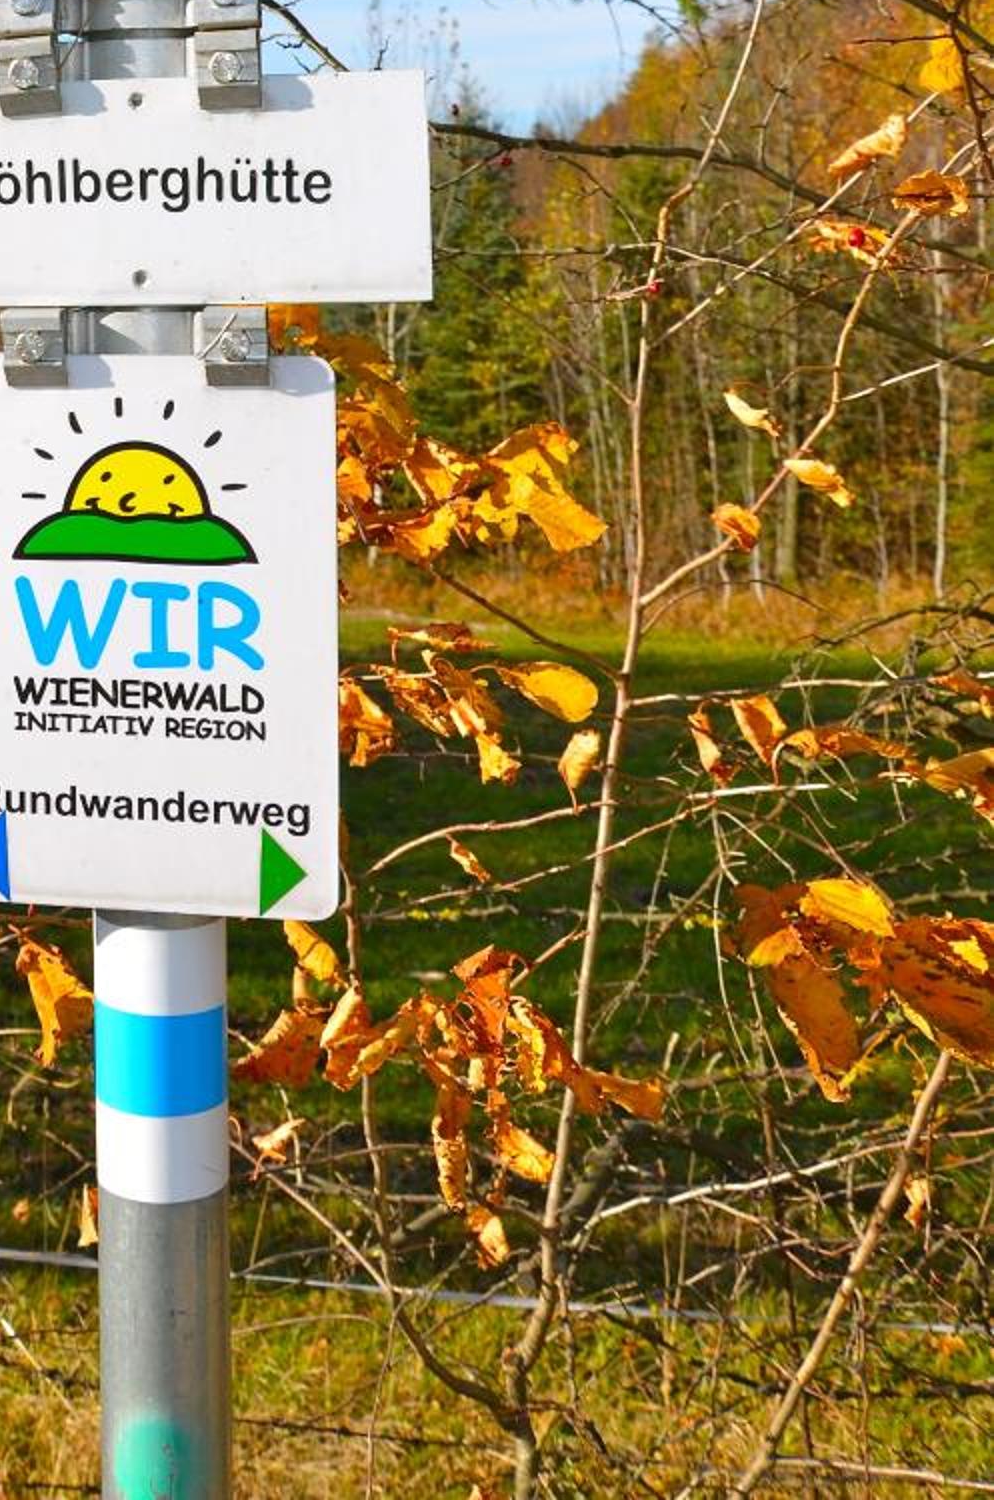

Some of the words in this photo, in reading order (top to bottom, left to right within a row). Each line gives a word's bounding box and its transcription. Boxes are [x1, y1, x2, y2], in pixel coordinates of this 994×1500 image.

[14, 575, 265, 672] WIR
[13, 675, 265, 714] WIENERWALD
[14, 712, 154, 737] INITIATIV
[165, 715, 267, 742] REGION
